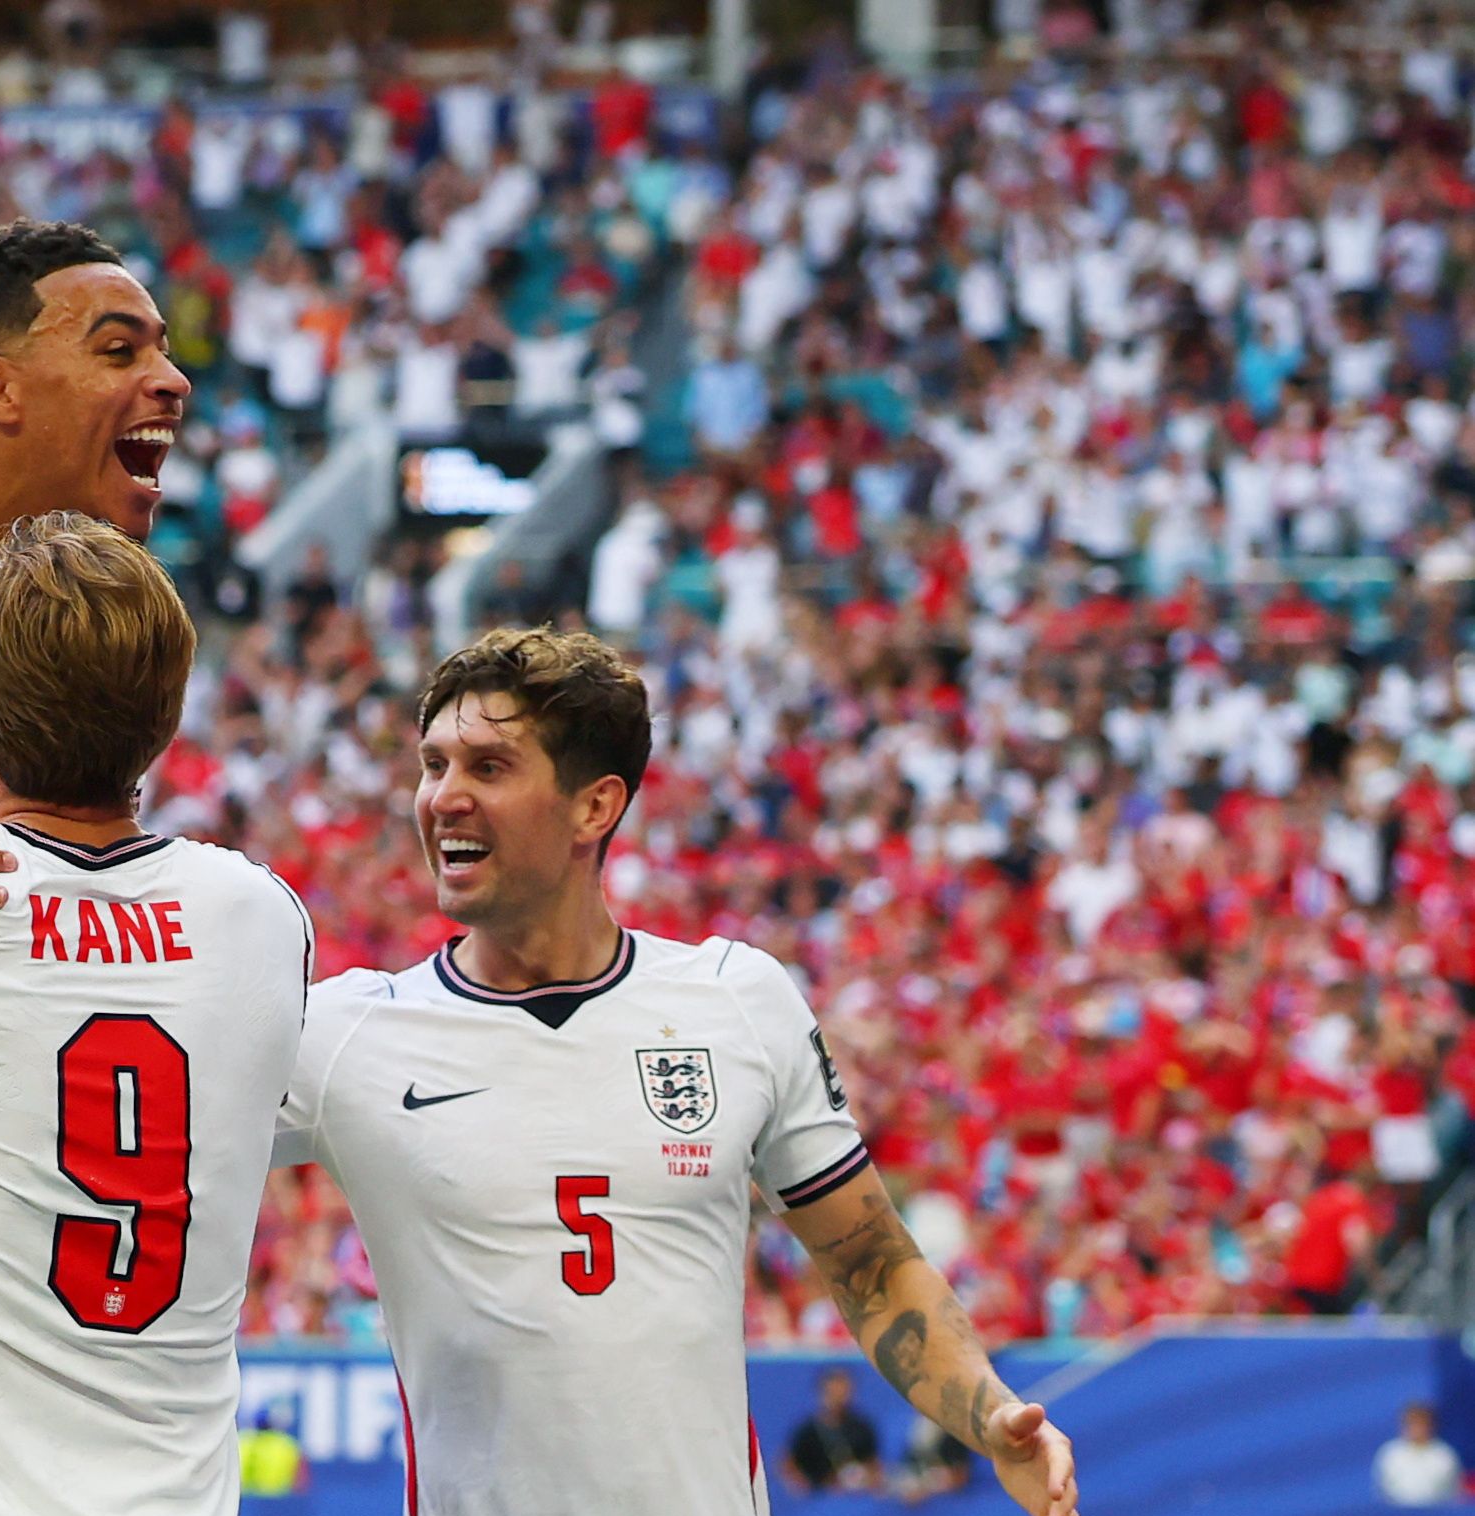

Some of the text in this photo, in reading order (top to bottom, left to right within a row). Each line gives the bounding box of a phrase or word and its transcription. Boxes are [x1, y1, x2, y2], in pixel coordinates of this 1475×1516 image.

[28, 894, 194, 965] KANE
[48, 1012, 193, 1335] 9
[661, 1143, 713, 1158] NORWAY
[555, 1175, 616, 1297] 5
[239, 1363, 403, 1462] FIF
